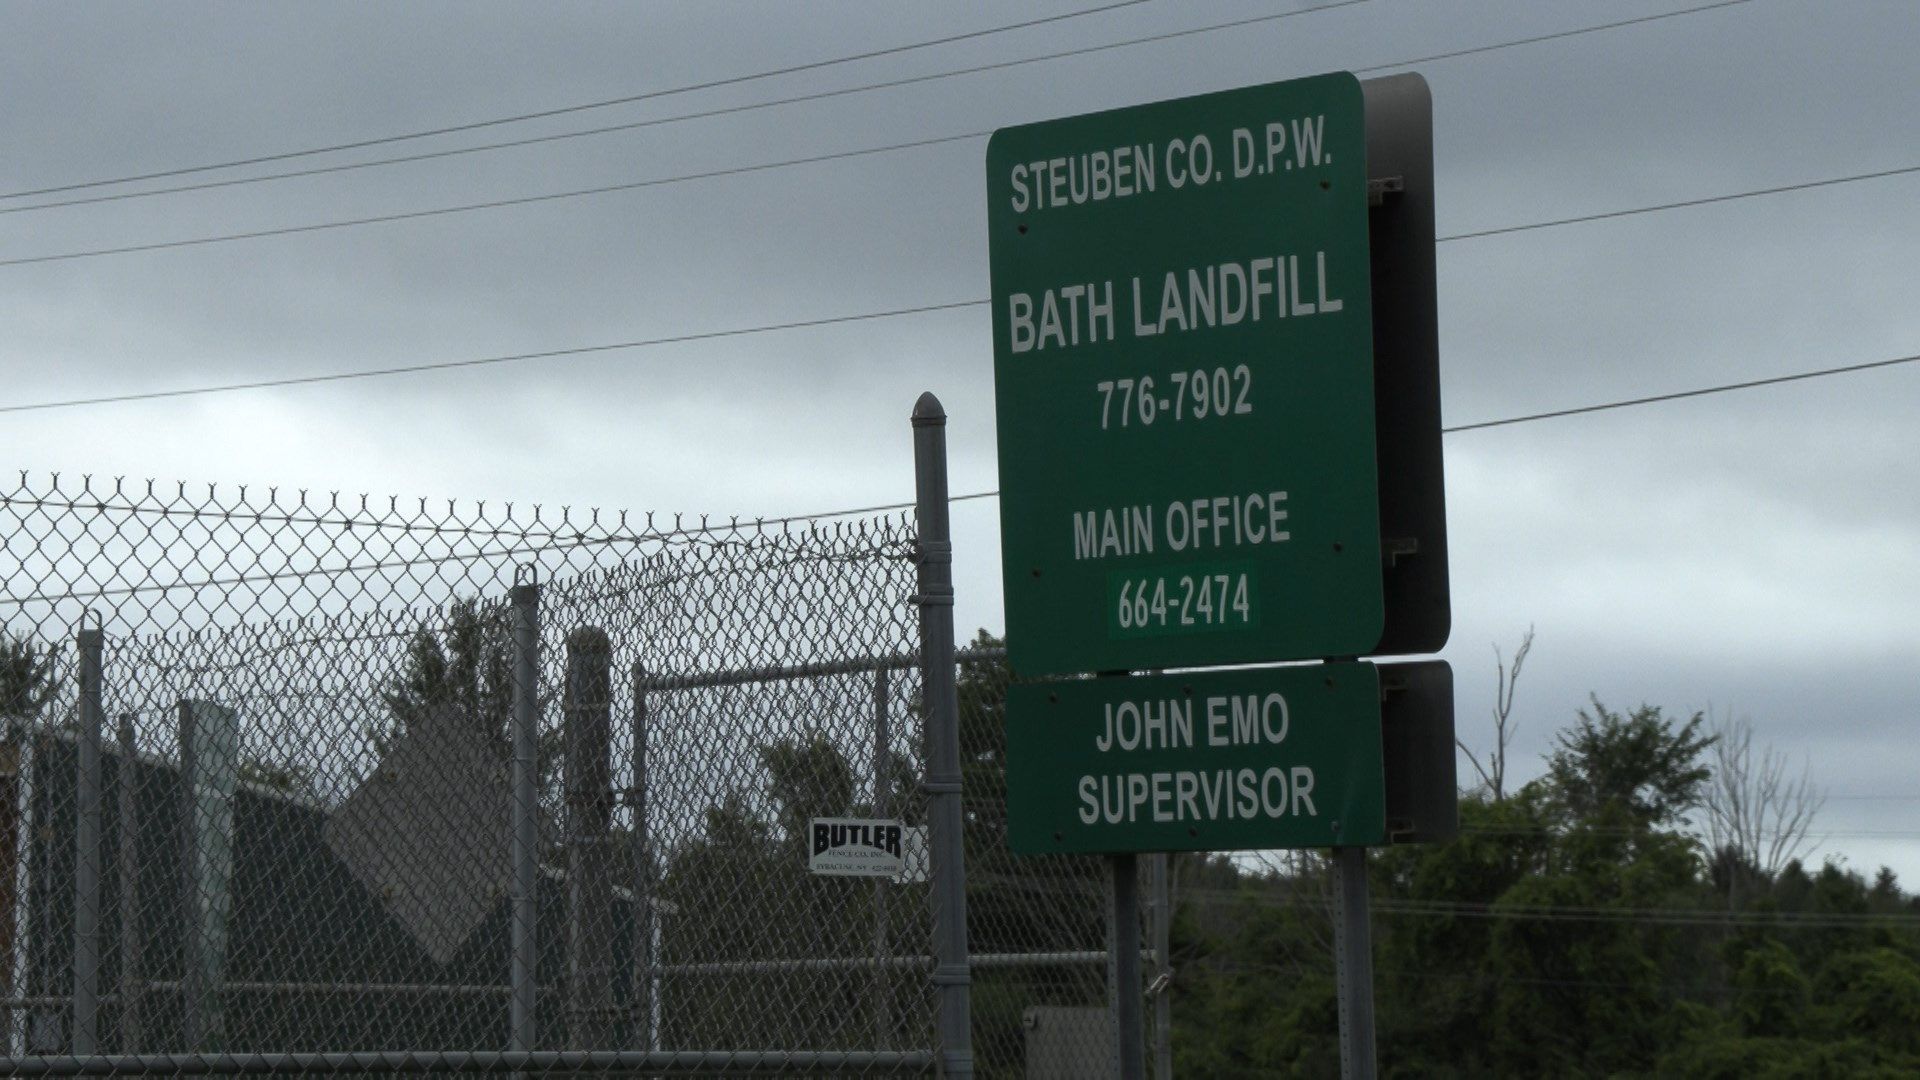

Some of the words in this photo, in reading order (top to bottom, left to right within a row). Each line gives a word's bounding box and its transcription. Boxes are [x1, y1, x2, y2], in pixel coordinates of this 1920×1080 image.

[1011, 142, 1156, 213] STEUBEN
[1166, 134, 1222, 188] CO.
[1233, 115, 1332, 179] D.P.W.
[1009, 280, 1115, 354] BATH
[1133, 250, 1344, 337] LANDFILL
[1097, 364, 1253, 429] 776-7902
[1074, 507, 1154, 561] MAIN
[1166, 490, 1291, 550] OFFICE
[1118, 573, 1250, 629] 664-2474
[1095, 701, 1194, 753] JOHN
[1207, 692, 1289, 747] EMO
[1078, 766, 1317, 825] SUPERVISOR
[813, 823, 901, 860] BUTLER
